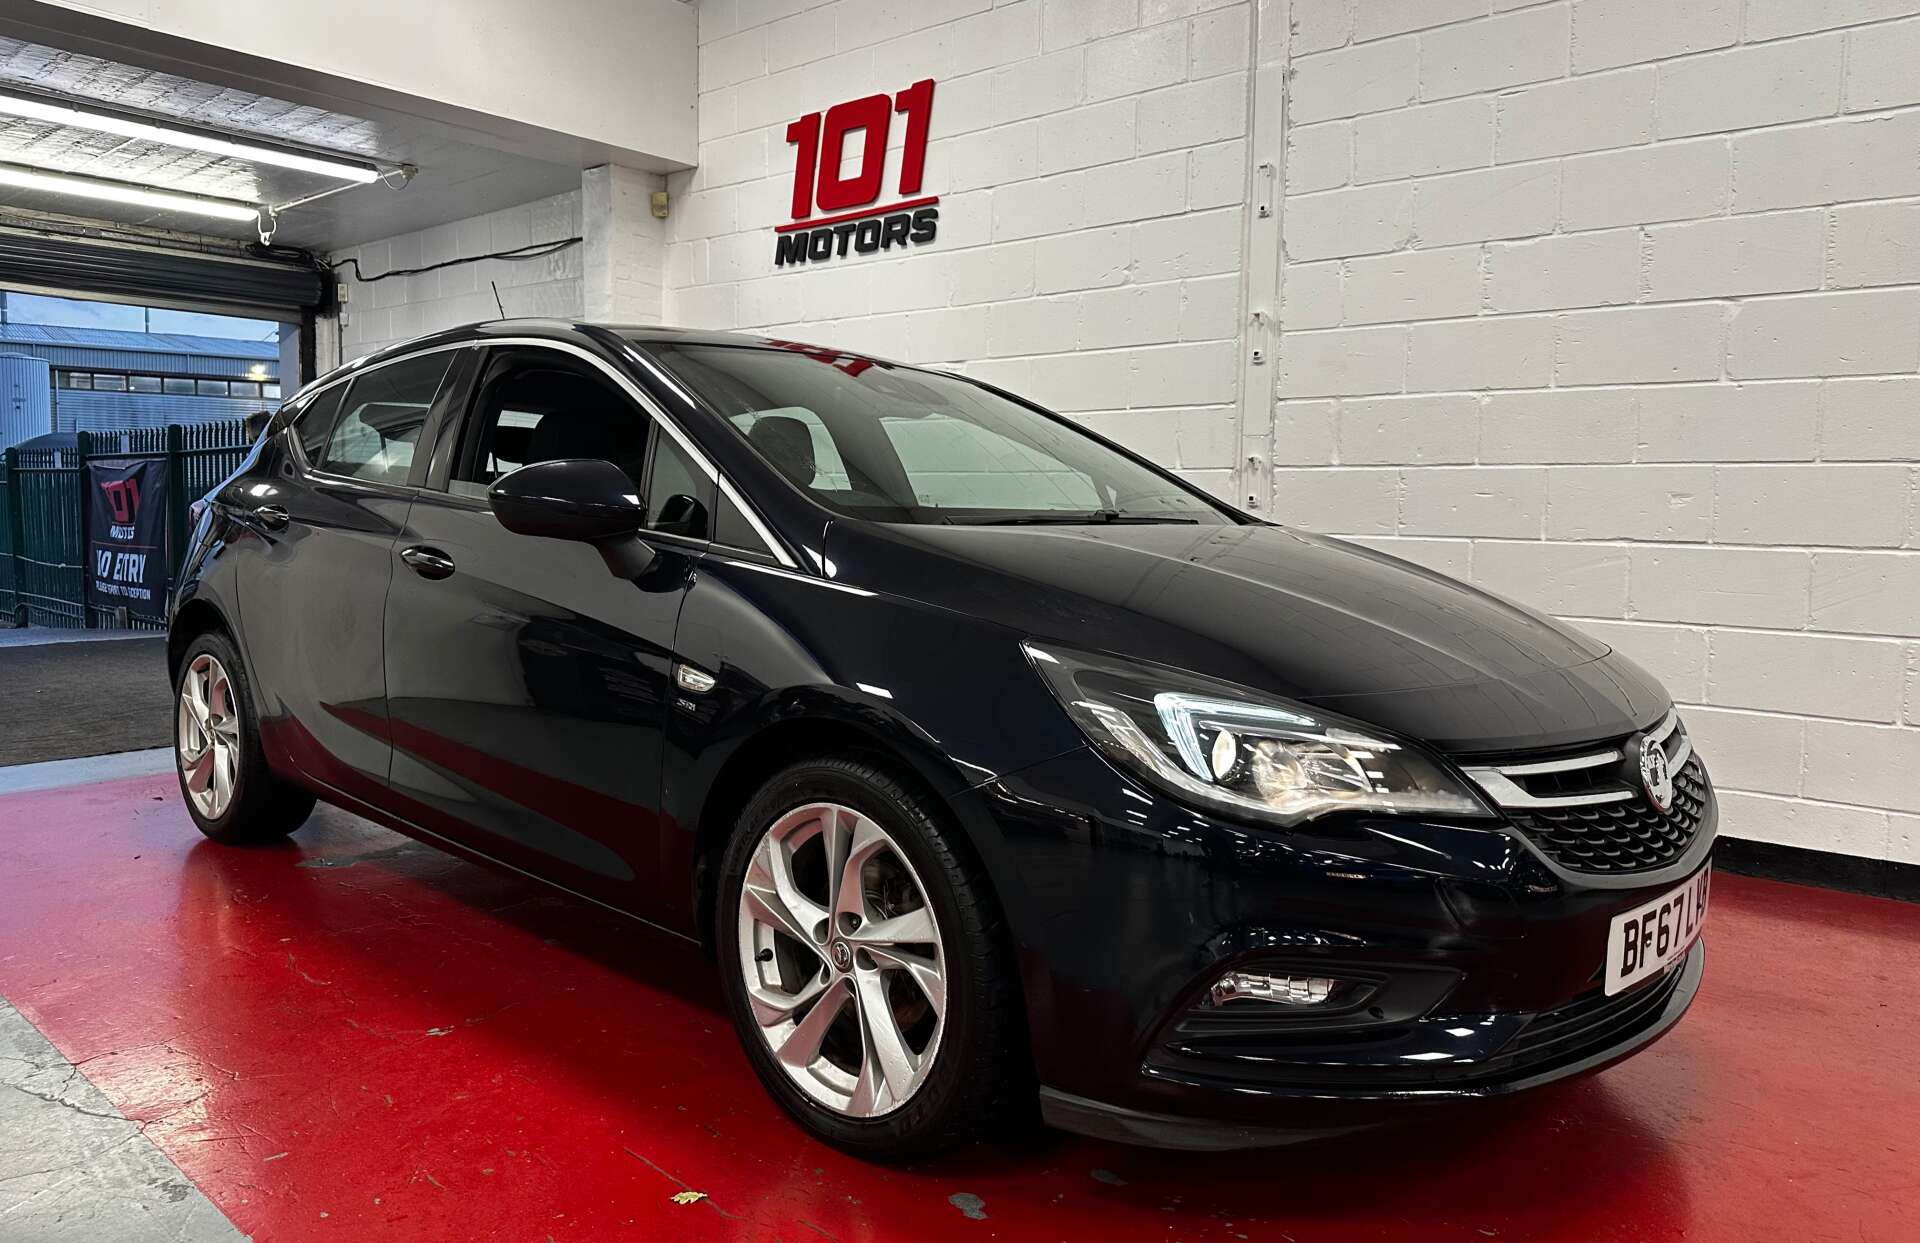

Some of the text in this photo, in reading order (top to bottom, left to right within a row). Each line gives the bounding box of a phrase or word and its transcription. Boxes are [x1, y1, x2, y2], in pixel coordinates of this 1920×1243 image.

[786, 78, 935, 219] 101
[775, 208, 939, 265] MOTORS
[128, 586, 151, 600] CEPTION
[1620, 893, 1685, 978] BF67
